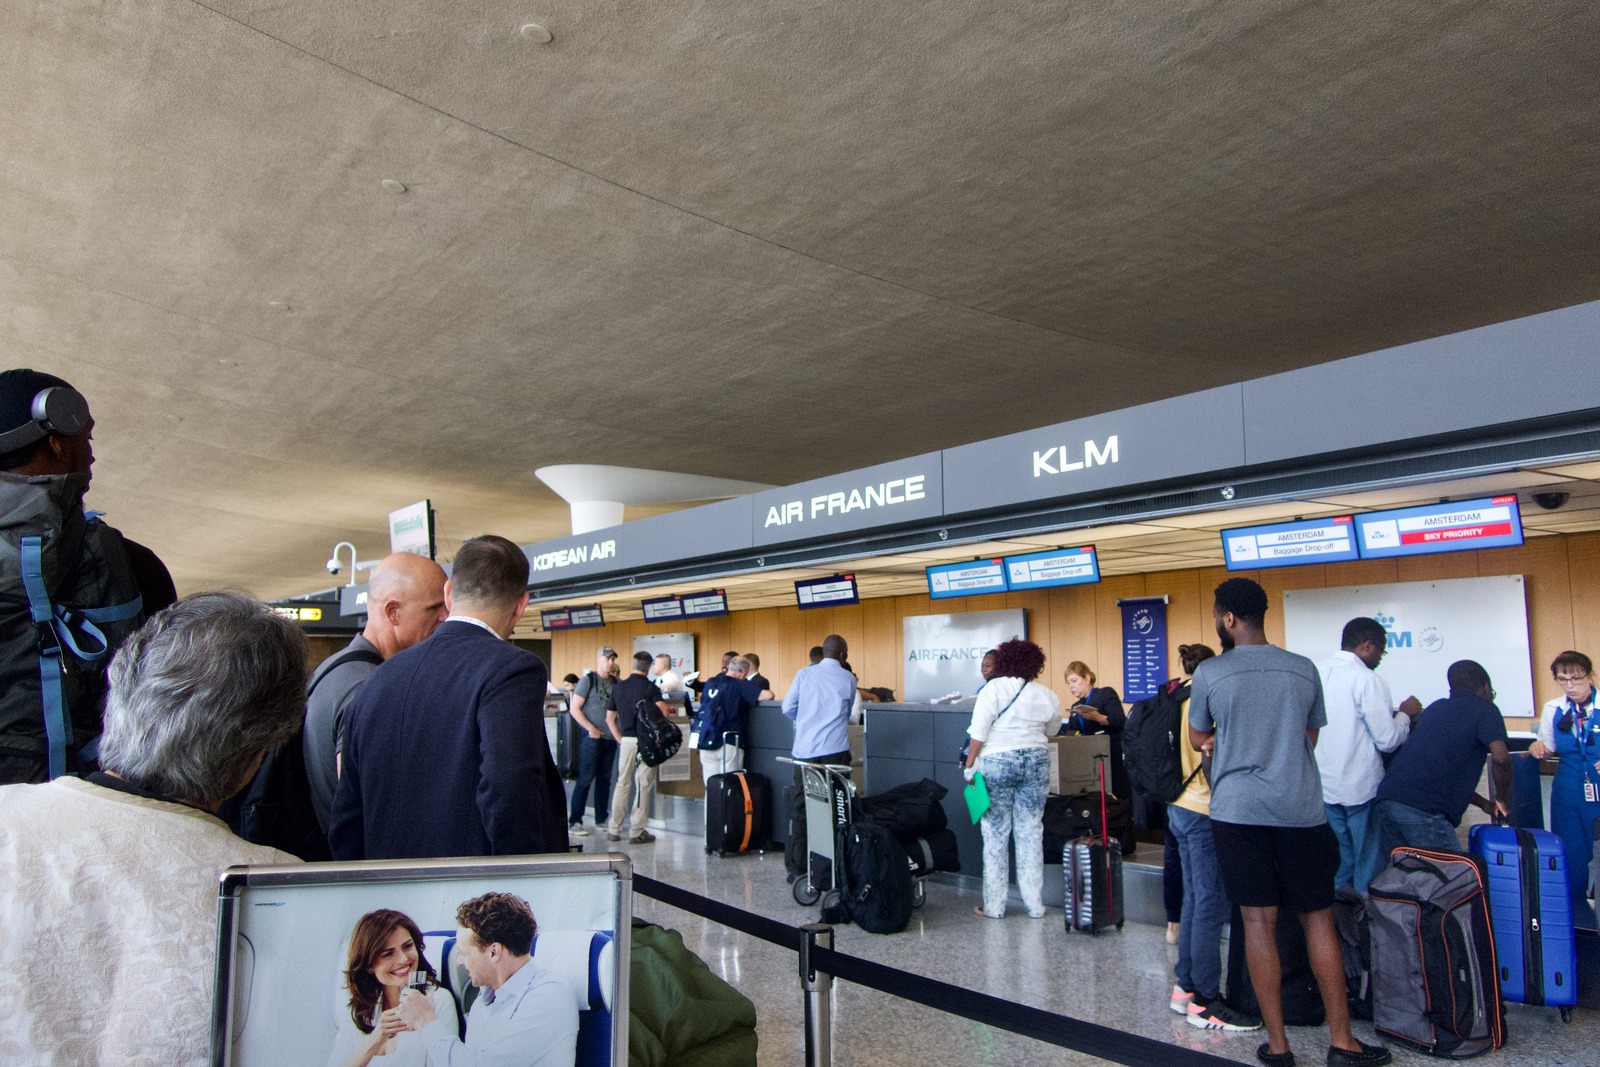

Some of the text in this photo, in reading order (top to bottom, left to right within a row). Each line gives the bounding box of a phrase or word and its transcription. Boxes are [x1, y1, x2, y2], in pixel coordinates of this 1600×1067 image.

[1032, 434, 1120, 478] KLM
[764, 475, 926, 528] AIR FRANCE
[1424, 513, 1481, 526] AMSTERDAM
[1278, 530, 1325, 543] AMSTERDAM
[1424, 525, 1484, 541] SKY PRIORITY
[533, 540, 616, 571] KOREAN AIR
[1273, 543, 1335, 558] Baggage Drop-off
[1043, 558, 1076, 567] AMSTERDAM
[1041, 570, 1062, 579] Baggage
